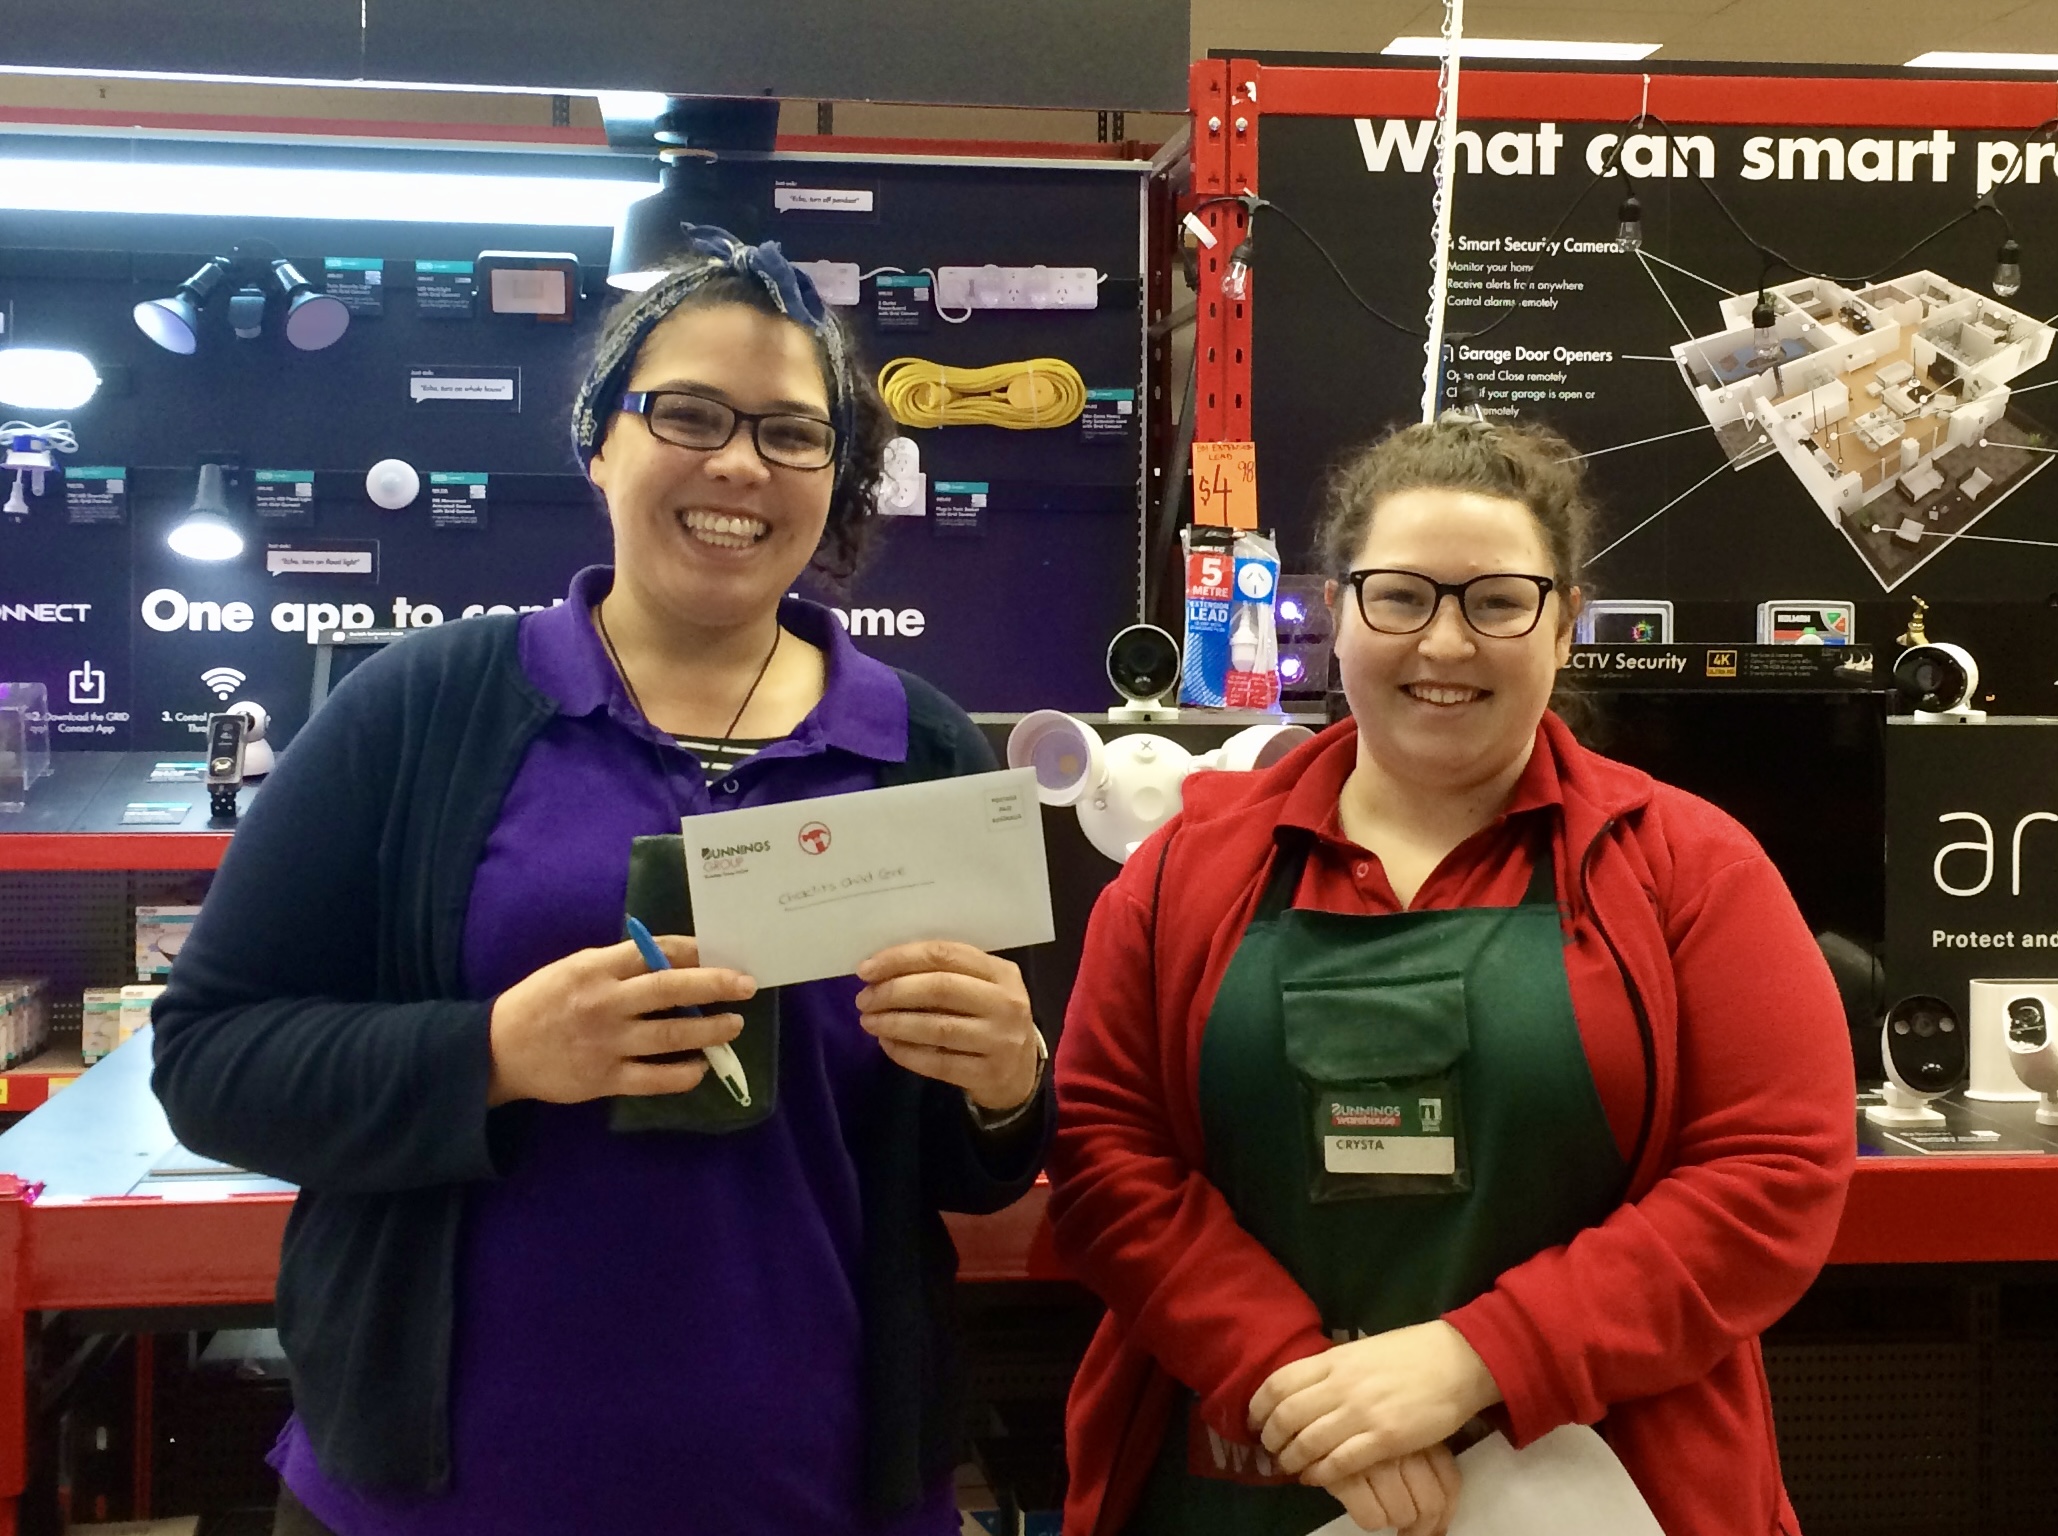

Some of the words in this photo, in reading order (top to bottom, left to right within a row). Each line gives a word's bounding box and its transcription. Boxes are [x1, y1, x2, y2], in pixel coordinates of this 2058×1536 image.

[1354, 118, 1563, 175] What
[1585, 132, 1715, 179] can
[1740, 129, 1955, 183] smart
[1977, 141, 2058, 196] pr
[1458, 236, 1501, 252] Smart
[1447, 262, 1484, 272] Monitor
[1486, 264, 1507, 274] your
[1447, 278, 1482, 289] Receive
[1486, 278, 1511, 290] alerts
[1537, 278, 1584, 292] anywhere
[1447, 295, 1481, 306] Control
[1458, 345, 1511, 364] Garage
[1515, 346, 1550, 361] Door
[1553, 346, 1613, 365] Openers
[1476, 370, 1495, 381] and
[1497, 370, 1524, 381] Close
[1526, 370, 1567, 384] remotely
[1487, 390, 1508, 400] your
[1511, 389, 1546, 401] garage
[1548, 388, 1557, 399] is
[1558, 390, 1583, 401] open
[1585, 391, 1596, 399] or
[1208, 453, 1232, 461] LEAD
[1201, 557, 1222, 587] 5
[1192, 586, 1229, 598] METRE
[141, 588, 254, 632] One
[271, 601, 375, 645] app
[392, 596, 444, 628] to
[1190, 607, 1228, 623] LEAD
[1615, 652, 1687, 674] Security
[1713, 653, 1731, 665] 4K
[44, 711, 89, 721] Download
[90, 711, 104, 721] the
[105, 712, 130, 721] GRID
[162, 711, 173, 722] 3.
[174, 711, 207, 722] Control
[57, 723, 94, 733] Connect
[95, 723, 115, 734] App
[701, 840, 771, 860] BUNNINGS
[702, 856, 744, 872] GROUP
[1932, 930, 2015, 948] Protect
[1331, 1103, 1401, 1117] BUNNINGS
[1335, 1139, 1385, 1150] CRYSTA
